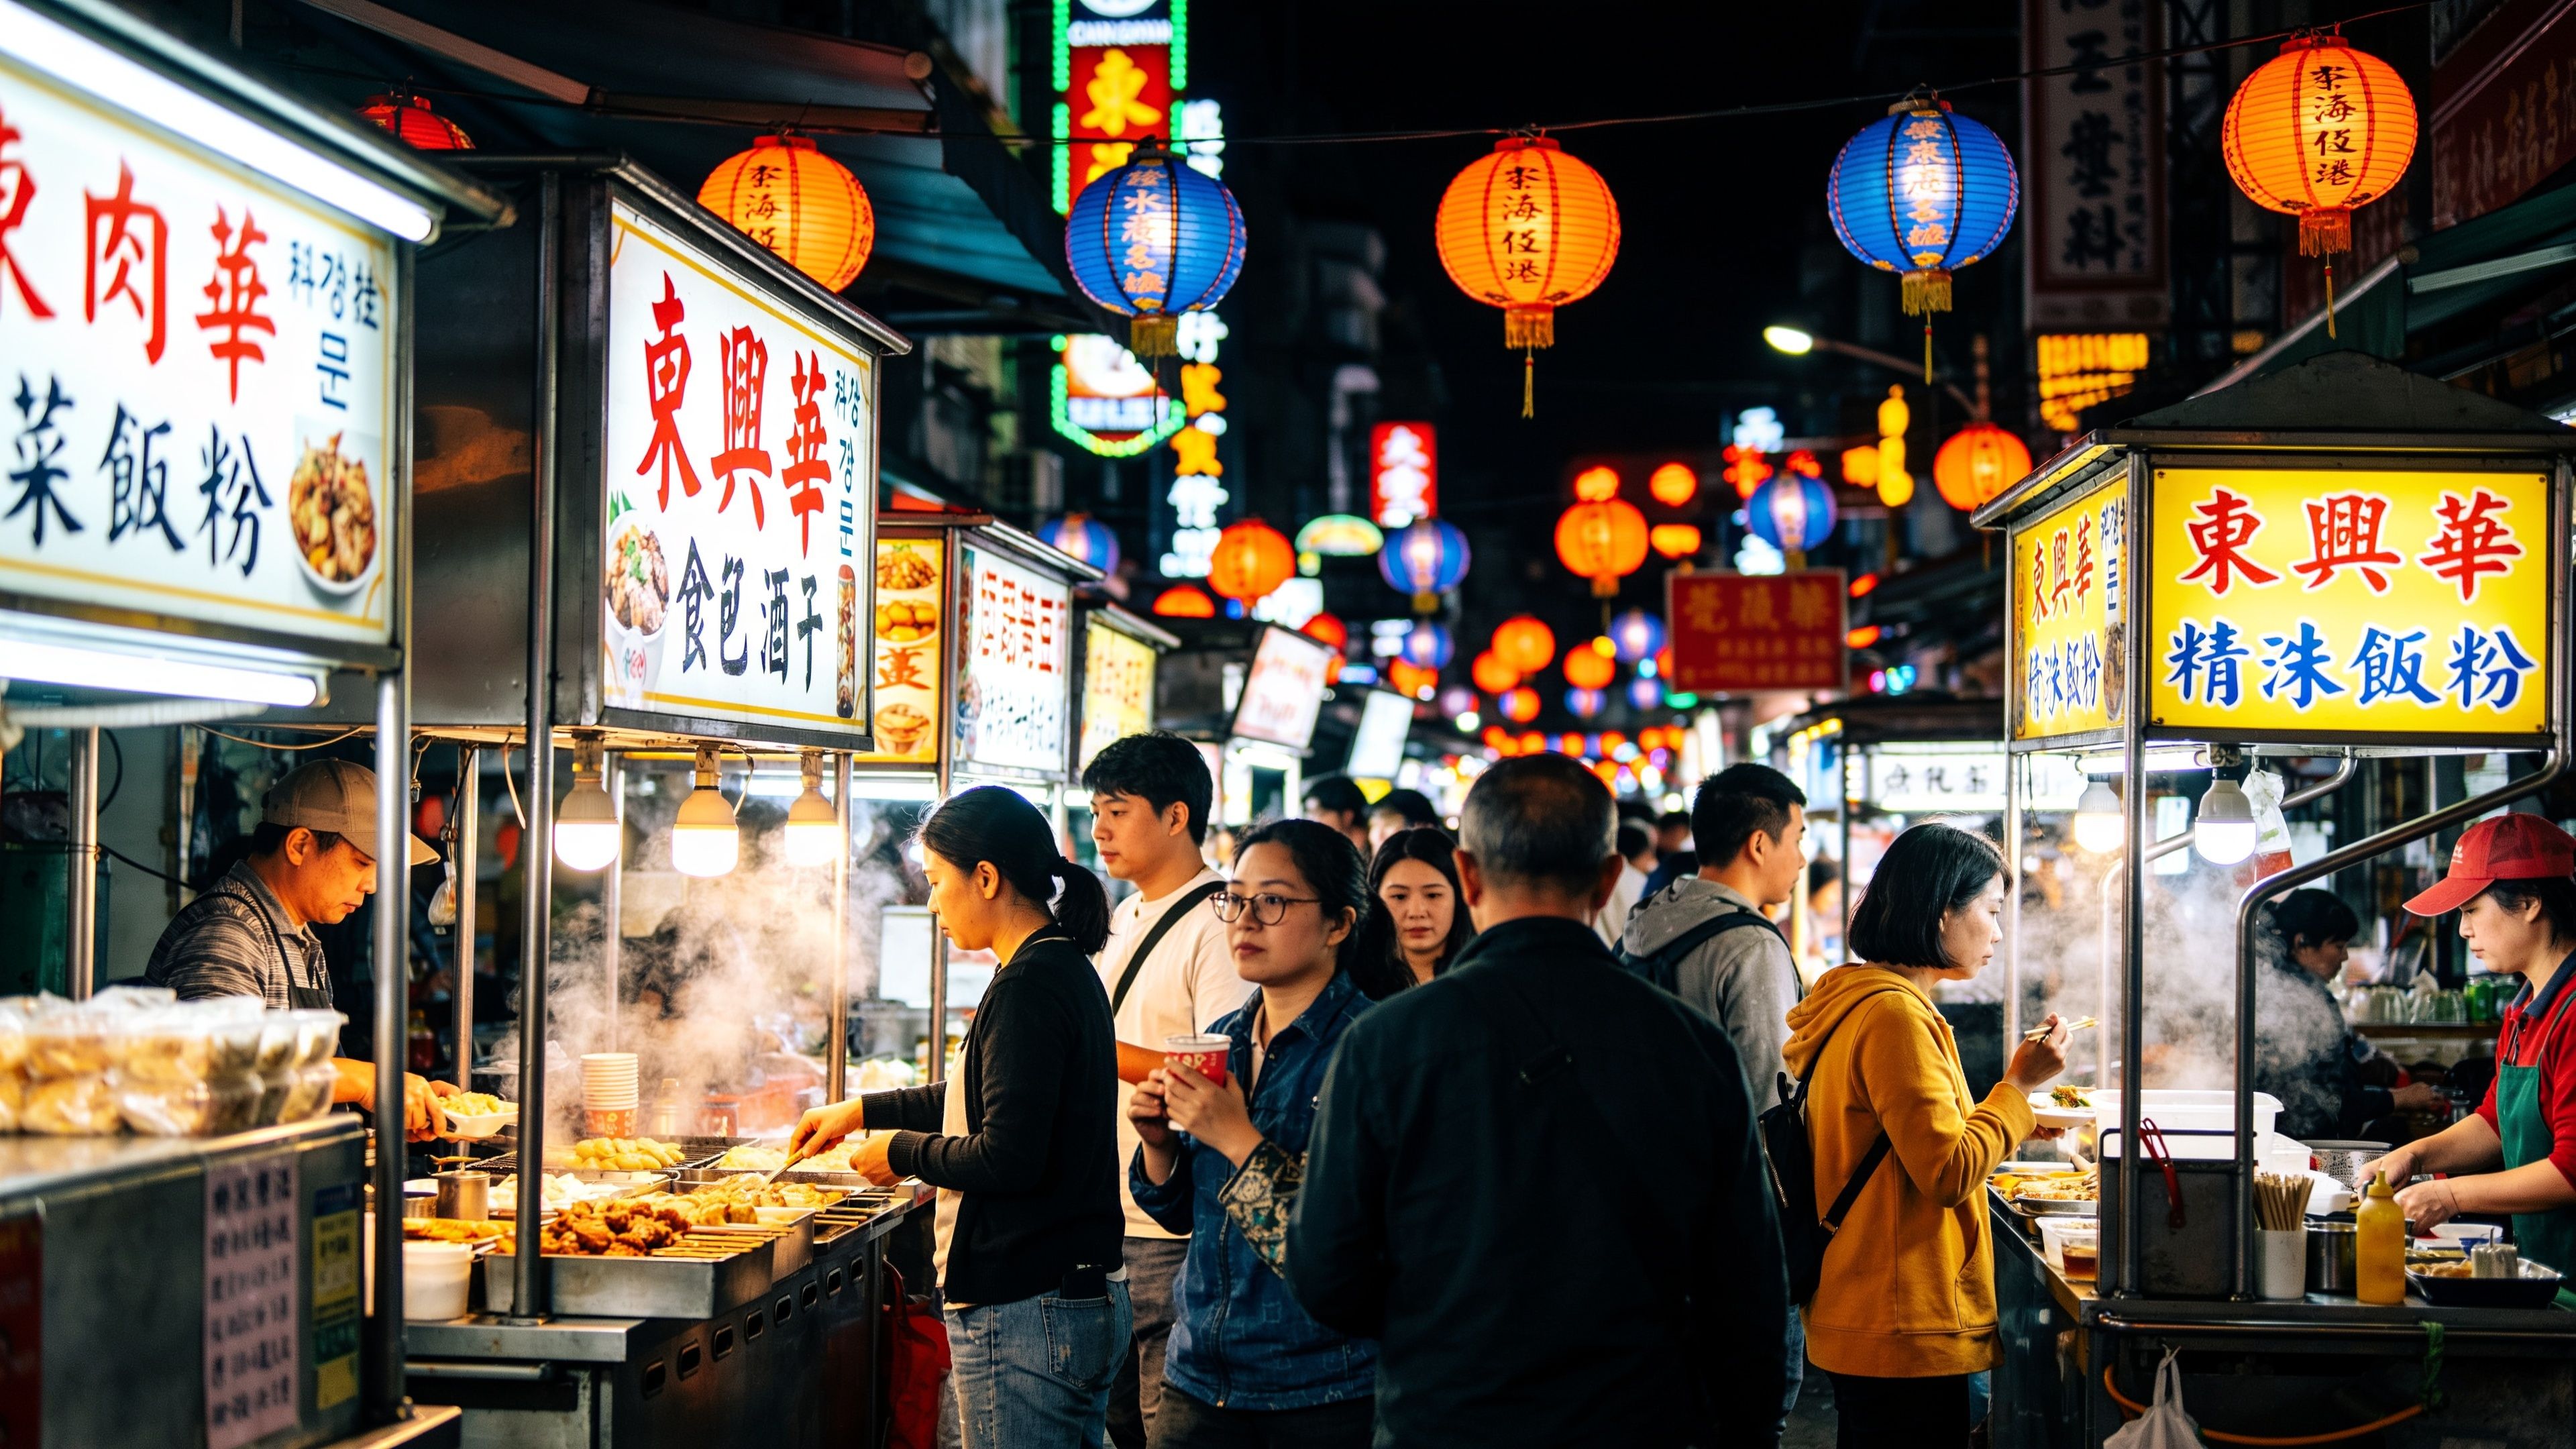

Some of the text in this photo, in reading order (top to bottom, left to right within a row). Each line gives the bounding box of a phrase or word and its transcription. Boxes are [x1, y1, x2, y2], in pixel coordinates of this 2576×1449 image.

[3, 373, 273, 578] 菜飯粉
[637, 270, 831, 559] 東興華
[2032, 514, 2094, 627] 東興華
[2180, 488, 2522, 602] 東興華
